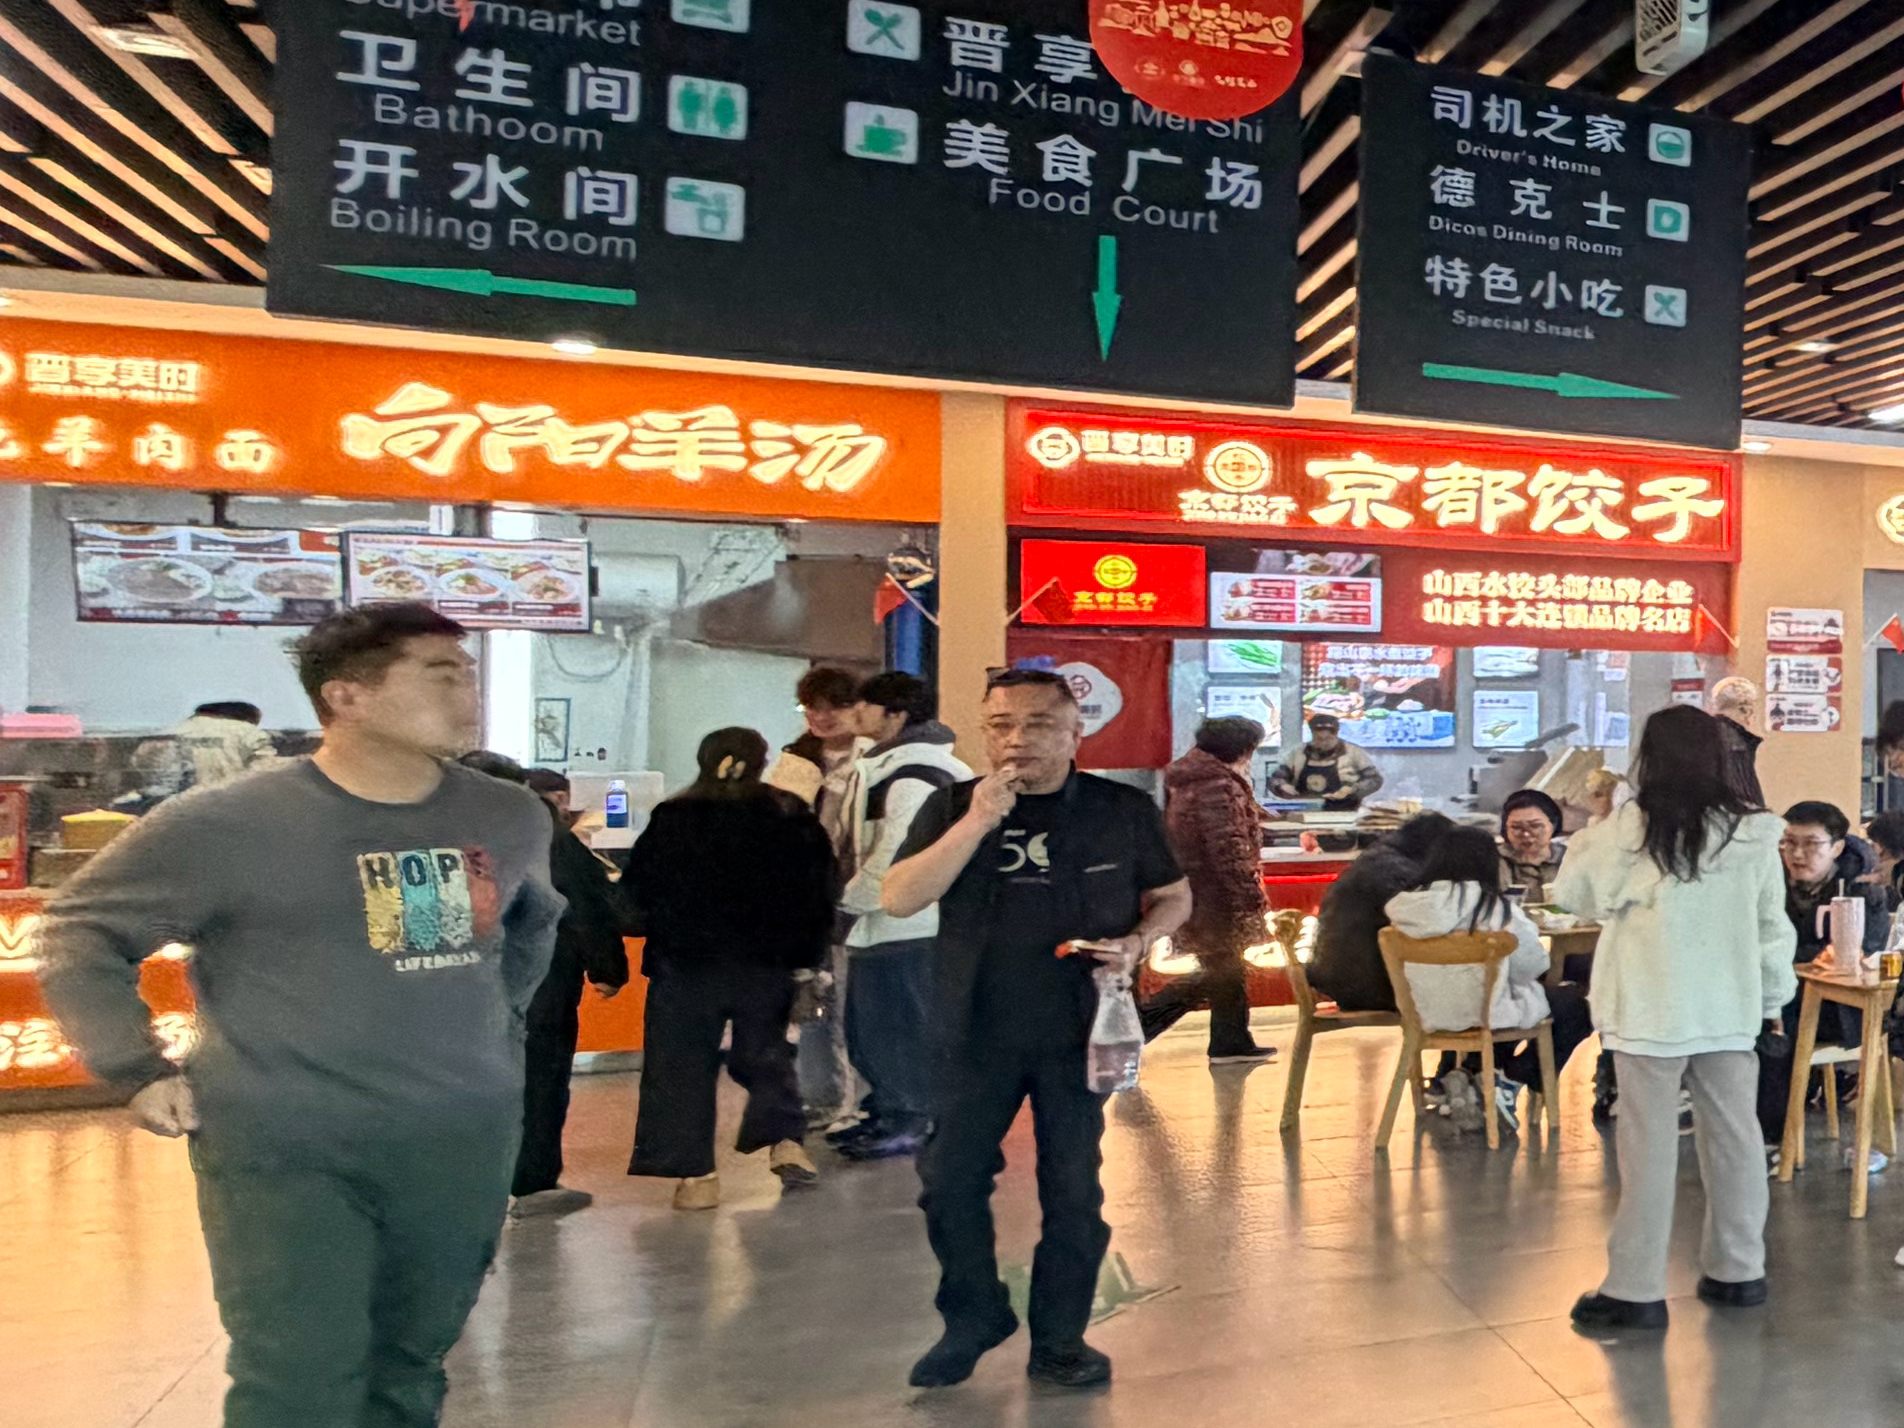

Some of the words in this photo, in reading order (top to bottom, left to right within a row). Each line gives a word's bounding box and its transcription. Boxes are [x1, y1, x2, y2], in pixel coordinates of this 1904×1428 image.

[336, 30, 640, 123] 卫生间
[942, 71, 998, 102] Jin
[1011, 79, 1120, 126] Xiang
[1205, 116, 1263, 144] Shi
[373, 93, 603, 151] Bathoom
[1431, 86, 1627, 153] 司机之家
[333, 139, 638, 226] 开水间
[943, 118, 1262, 210] 美食广场
[1456, 140, 1536, 167] Driver's
[1543, 155, 1601, 176] Home
[330, 197, 492, 249] Boiling
[509, 219, 637, 260] Room
[989, 178, 1090, 215] Food
[1113, 195, 1218, 233] Court
[1430, 164, 1625, 231] 德克士
[1493, 226, 1559, 250] Dining
[1565, 235, 1623, 258] Room
[1425, 255, 1624, 318] 特色小吃
[1453, 309, 1529, 334] Special
[1535, 319, 1595, 340] Snack
[25, 351, 199, 389] 晋享美时
[341, 382, 888, 493] 向阳羊汤
[1306, 451, 1725, 542] 京都饺子
[1422, 569, 1695, 603] 山西水饺头部品牌企业
[1422, 598, 1691, 633] 山西十大连锁品牌名店
